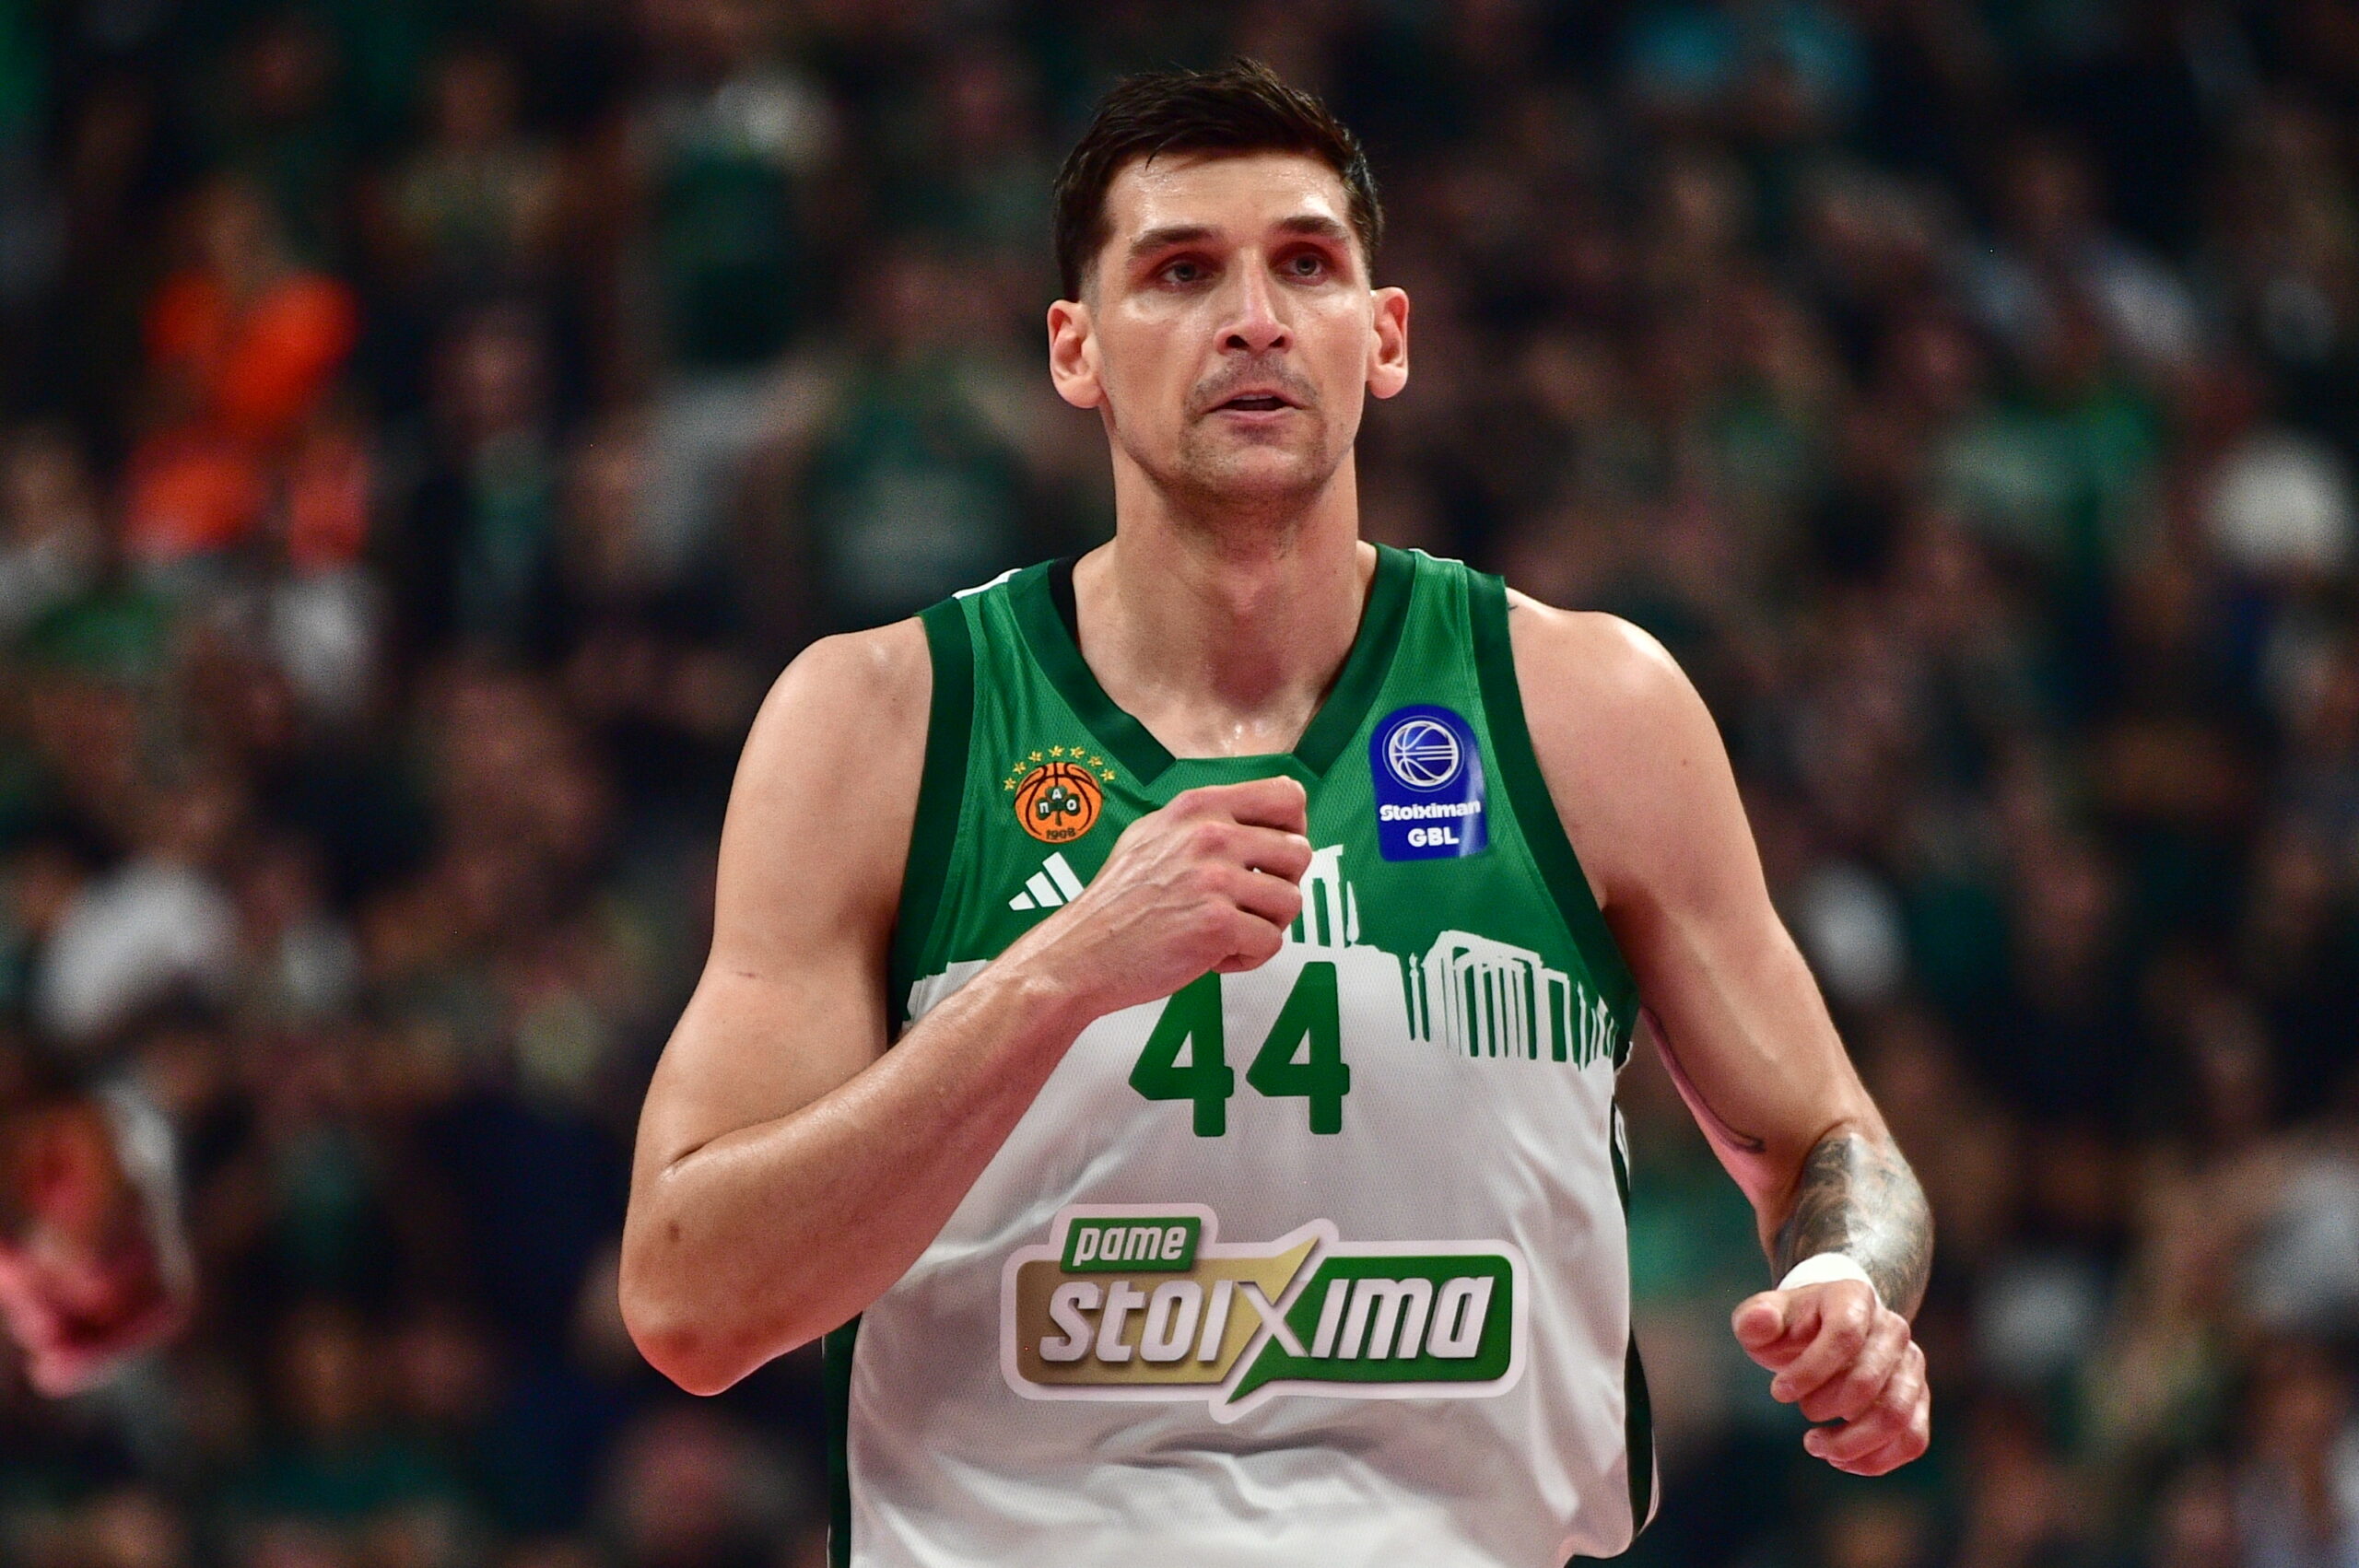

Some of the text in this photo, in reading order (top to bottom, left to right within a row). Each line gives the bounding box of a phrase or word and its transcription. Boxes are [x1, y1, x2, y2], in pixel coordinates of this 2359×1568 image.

[1379, 800, 1482, 821] Stoiximan
[1047, 827, 1076, 839] 1908
[1407, 826, 1460, 848] GBL
[1128, 961, 1350, 1137] 44
[1072, 1226, 1187, 1267] pame
